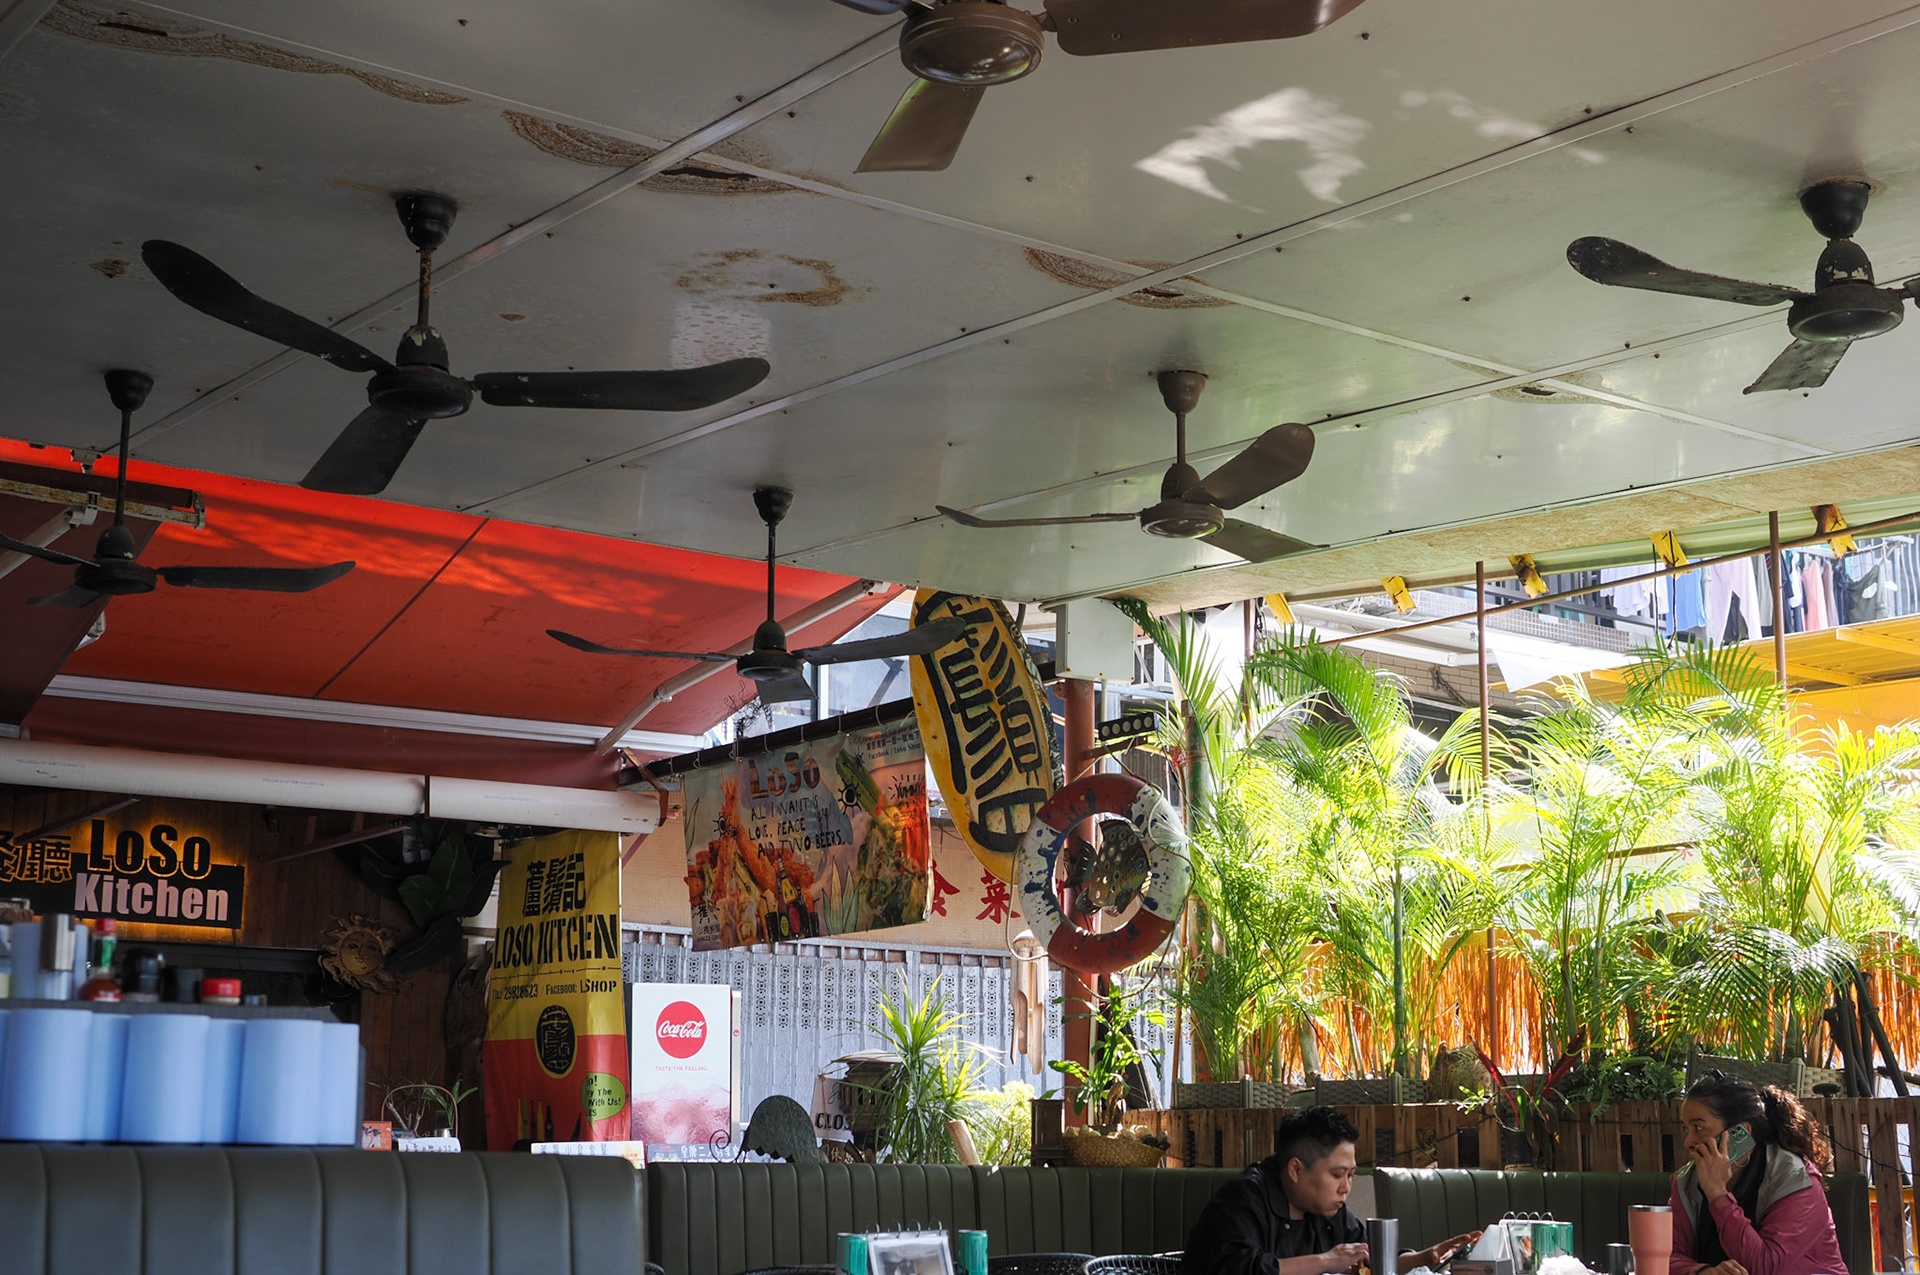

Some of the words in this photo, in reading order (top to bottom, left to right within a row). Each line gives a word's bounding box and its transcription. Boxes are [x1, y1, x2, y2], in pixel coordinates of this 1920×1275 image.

[777, 797, 809, 816] WANT
[777, 818, 806, 836] PEACE
[87, 820, 213, 879] LoSo
[779, 836, 811, 855] TWO
[74, 872, 230, 922] Kitchen
[536, 915, 618, 965] KITCEN
[658, 1020, 705, 1038] Coca-Cola
[597, 1088, 613, 1097] The
[607, 1097, 622, 1106] Us!
